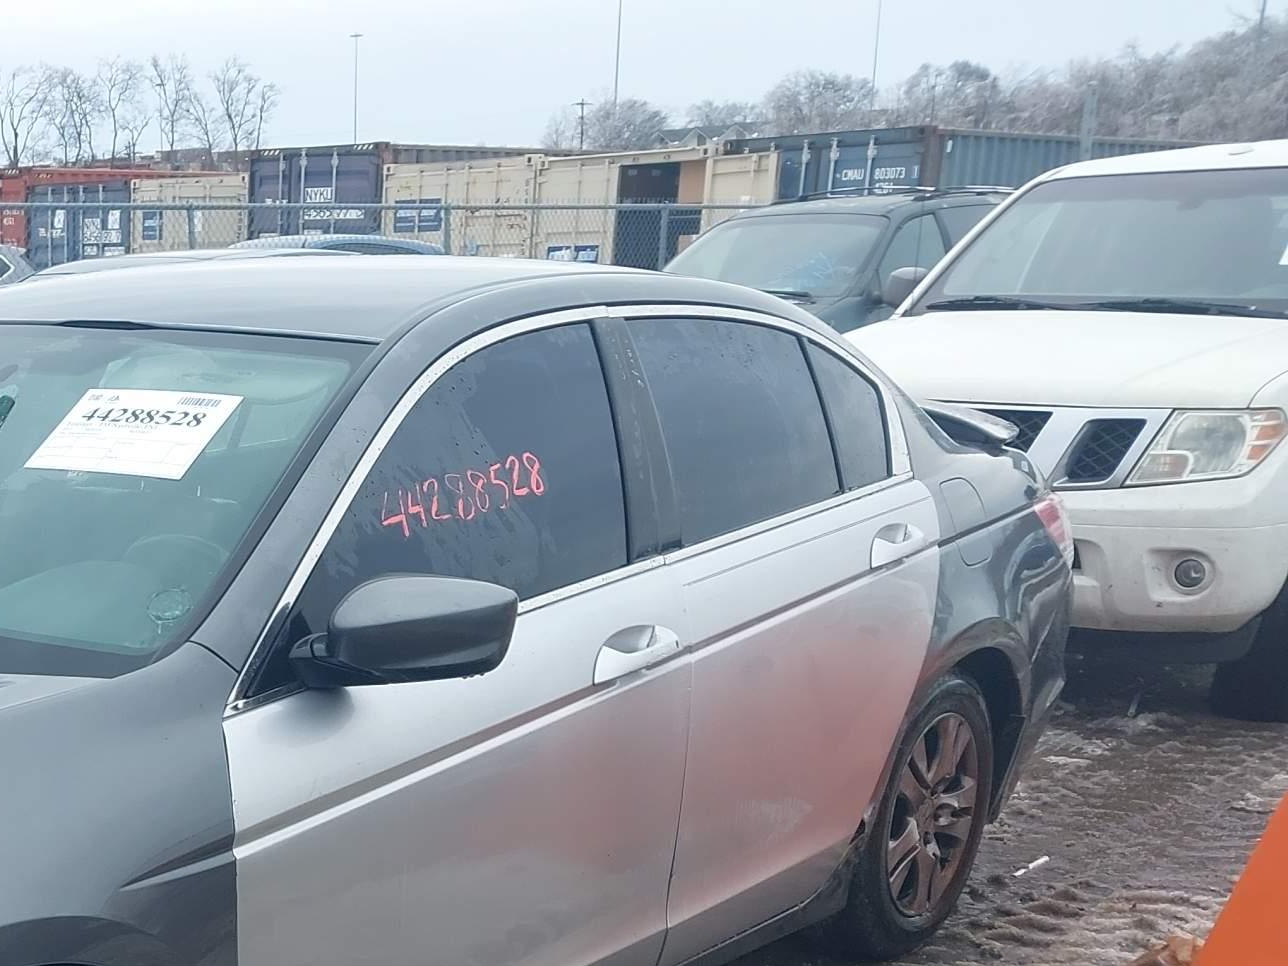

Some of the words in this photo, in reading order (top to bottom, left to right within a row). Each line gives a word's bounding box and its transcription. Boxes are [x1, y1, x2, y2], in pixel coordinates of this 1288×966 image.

[841, 169, 865, 181] CMAU
[874, 167, 906, 180] 803073
[81, 407, 207, 428] 44288528
[381, 452, 545, 537] 44288528
